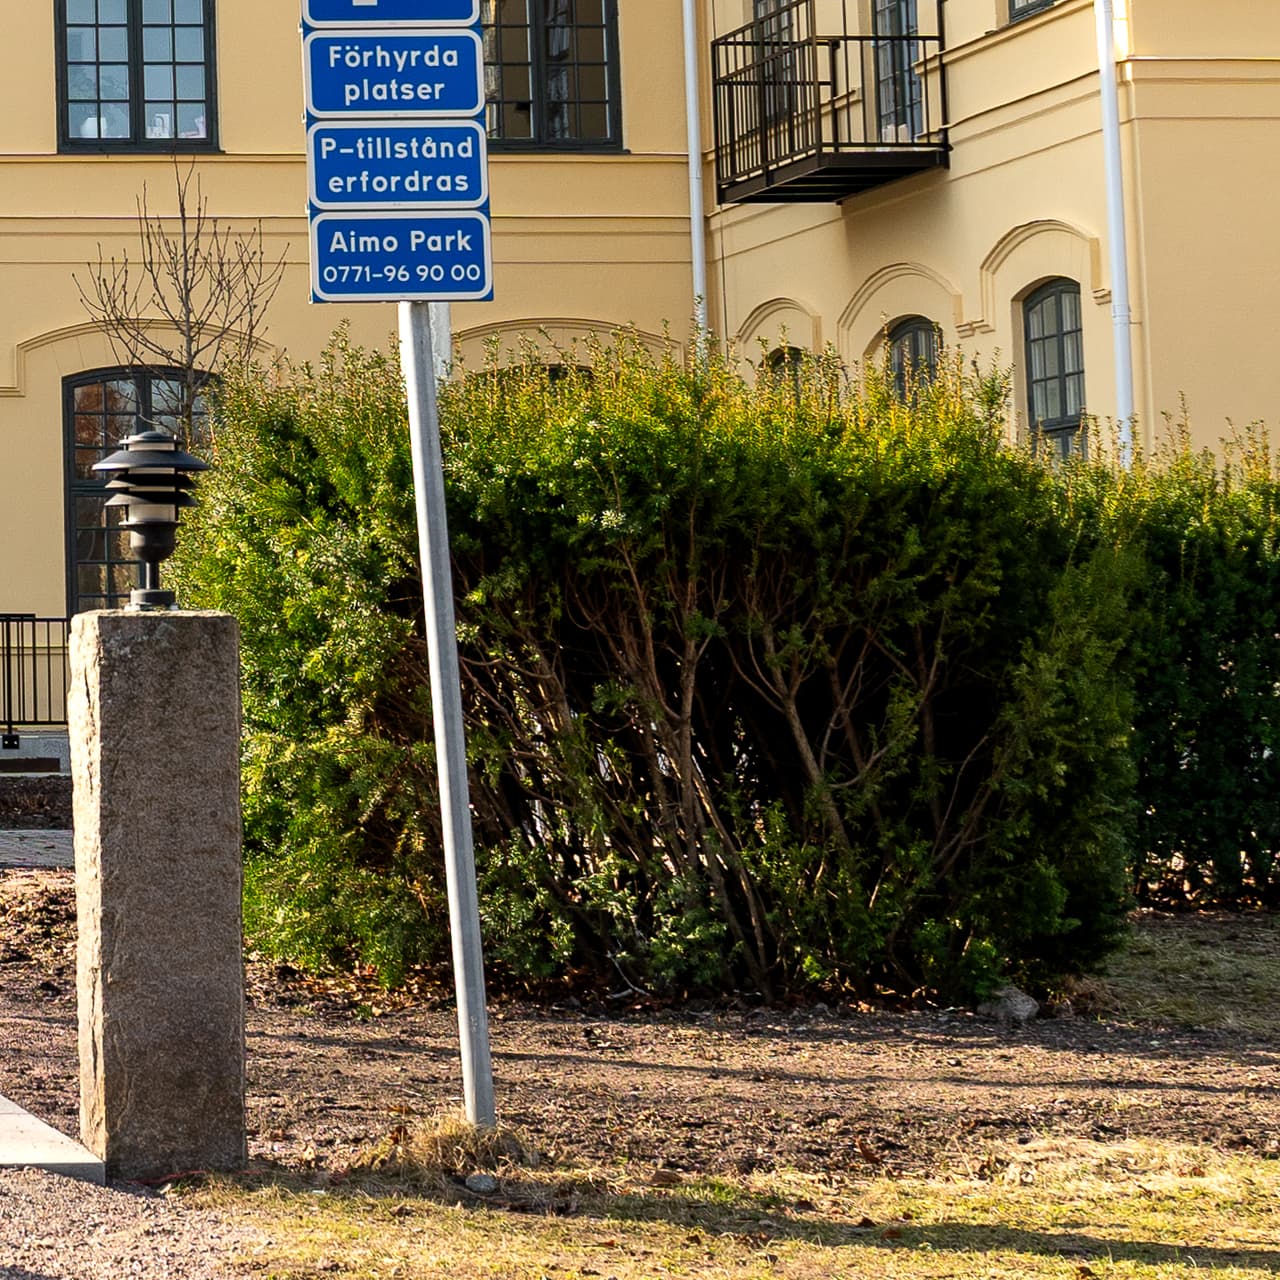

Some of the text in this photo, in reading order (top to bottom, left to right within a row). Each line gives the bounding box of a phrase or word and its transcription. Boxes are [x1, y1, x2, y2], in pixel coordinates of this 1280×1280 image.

[329, 44, 458, 73] Förhyrda
[344, 78, 445, 106] platser
[321, 136, 473, 160] P-tillstånd
[328, 170, 469, 193] erfordras
[329, 229, 472, 253] Aimo Park
[323, 264, 481, 283] 0771-96 90 00
